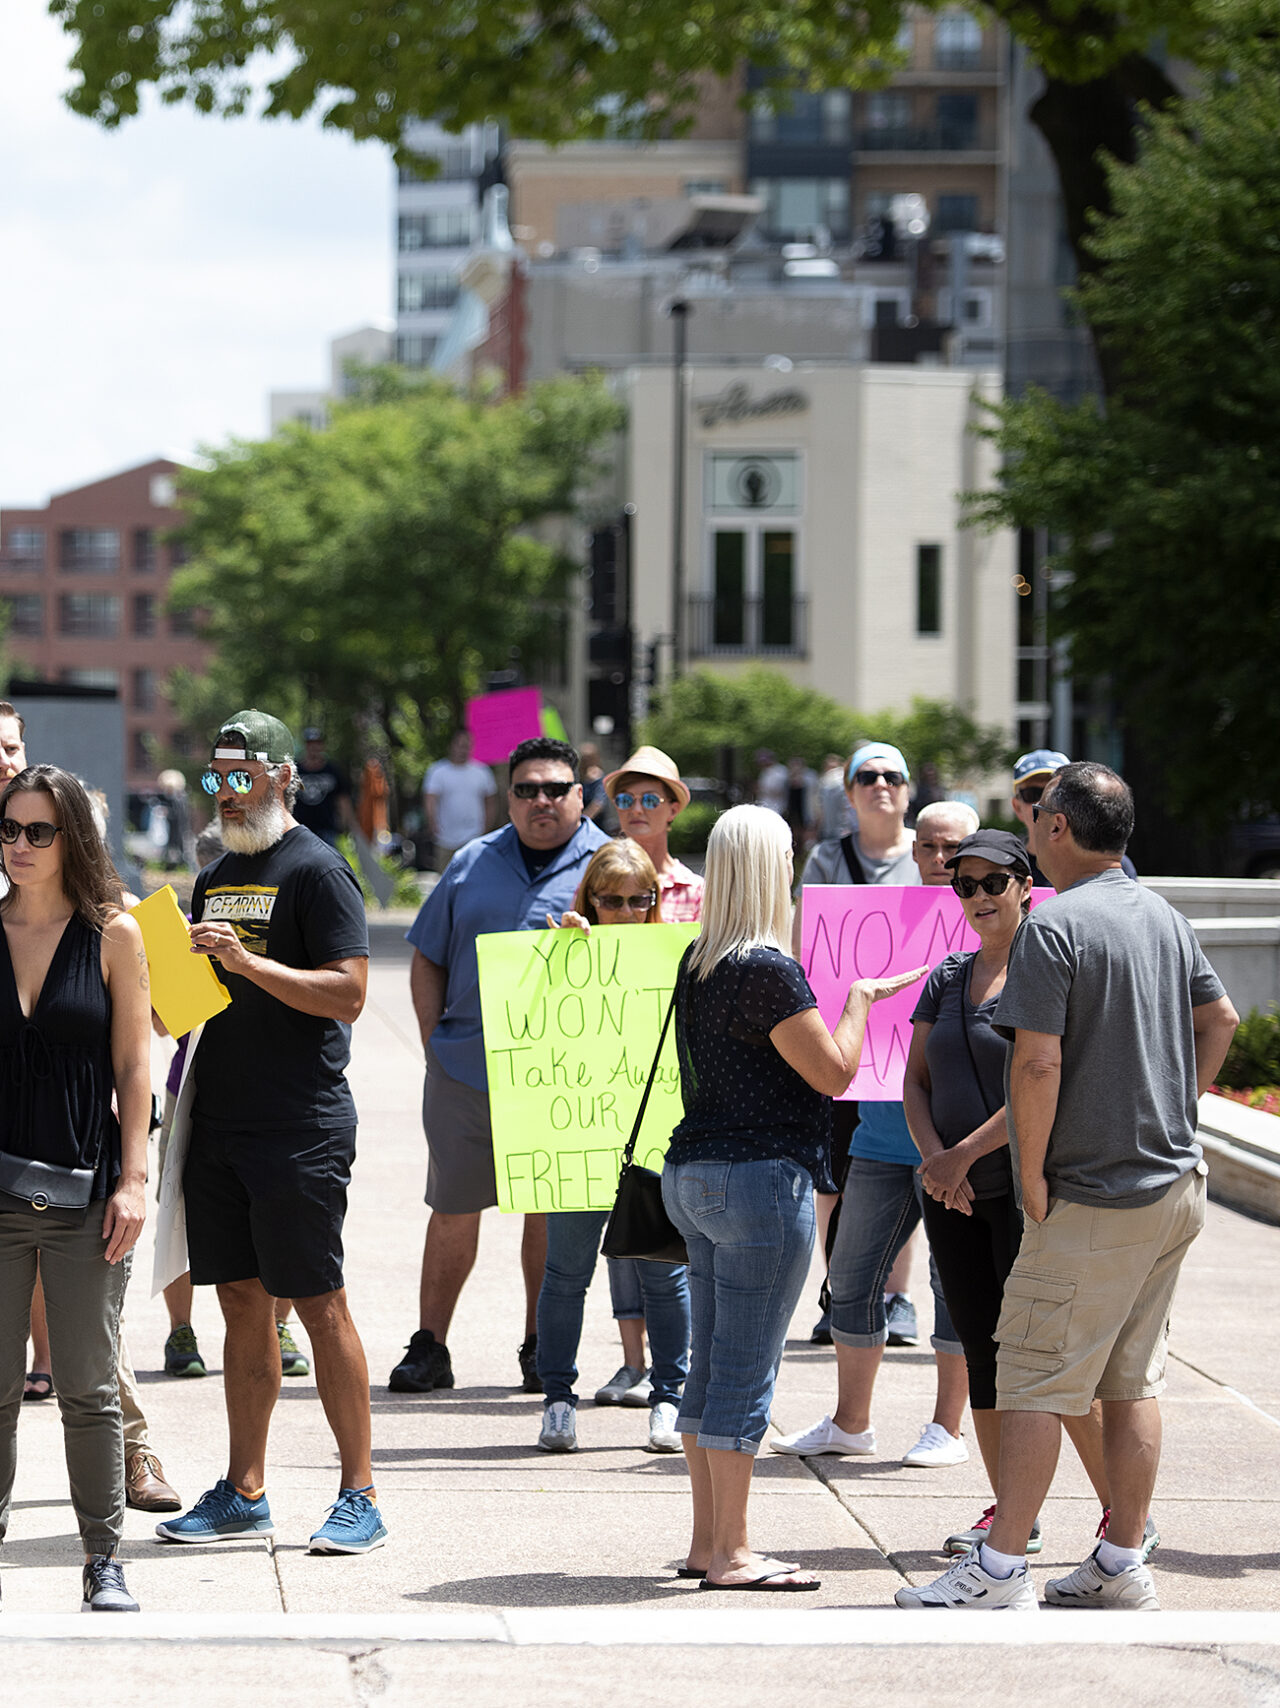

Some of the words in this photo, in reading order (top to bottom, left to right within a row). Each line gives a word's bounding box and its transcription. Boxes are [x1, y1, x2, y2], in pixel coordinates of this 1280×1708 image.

[532, 937, 622, 990] YOU
[807, 908, 895, 980] NO
[505, 987, 675, 1041] WON'T
[550, 1091, 625, 1134] OUR
